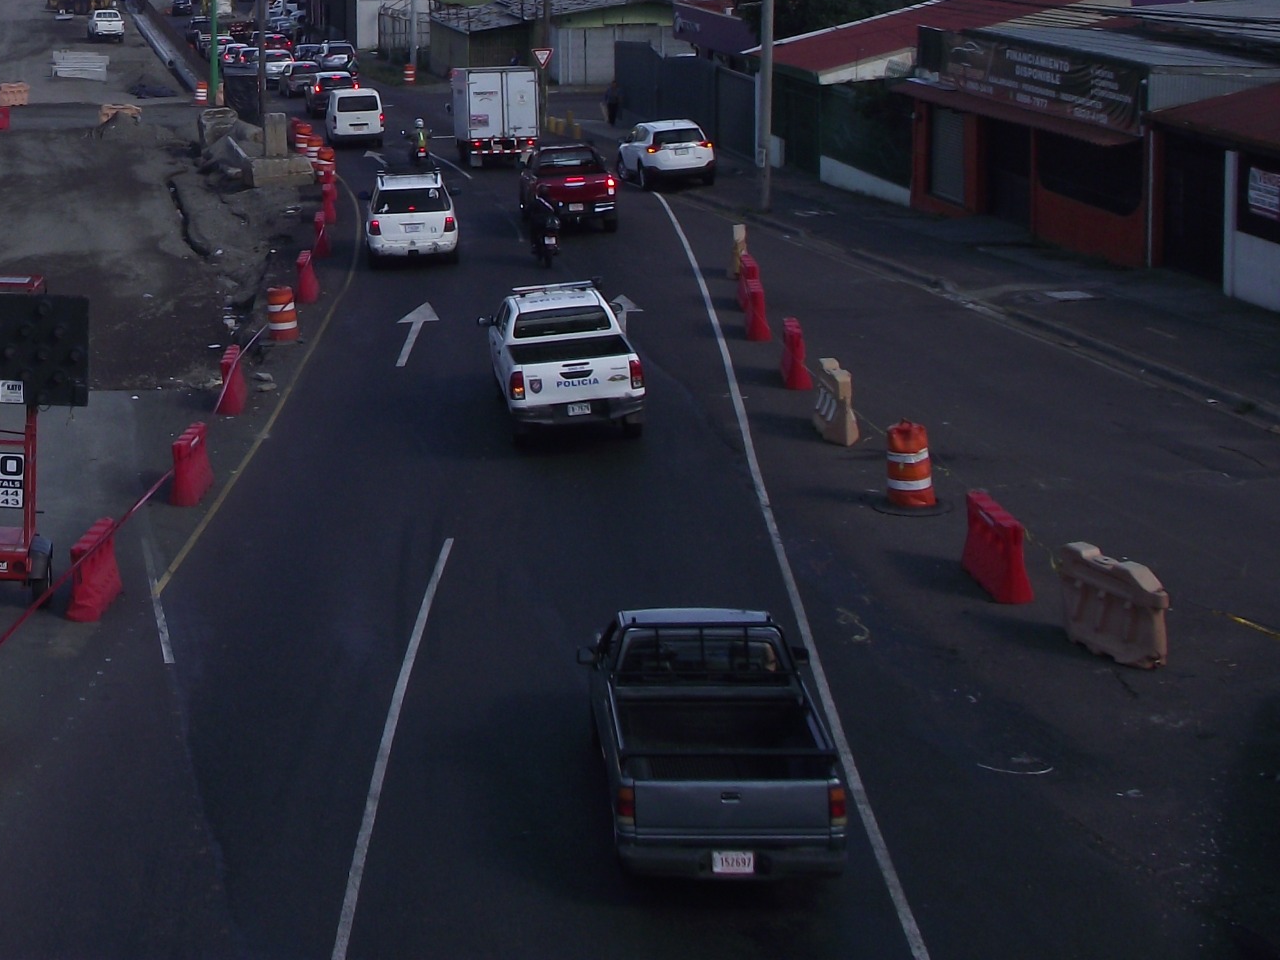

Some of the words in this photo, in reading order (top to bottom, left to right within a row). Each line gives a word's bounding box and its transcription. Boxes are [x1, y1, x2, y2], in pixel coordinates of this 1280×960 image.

[1006, 49, 1069, 72] FINANCIAMIENTO
[1015, 65, 1061, 85] DISPONIBLE
[556, 378, 599, 388] POLICIA
[721, 857, 752, 868] 152697
